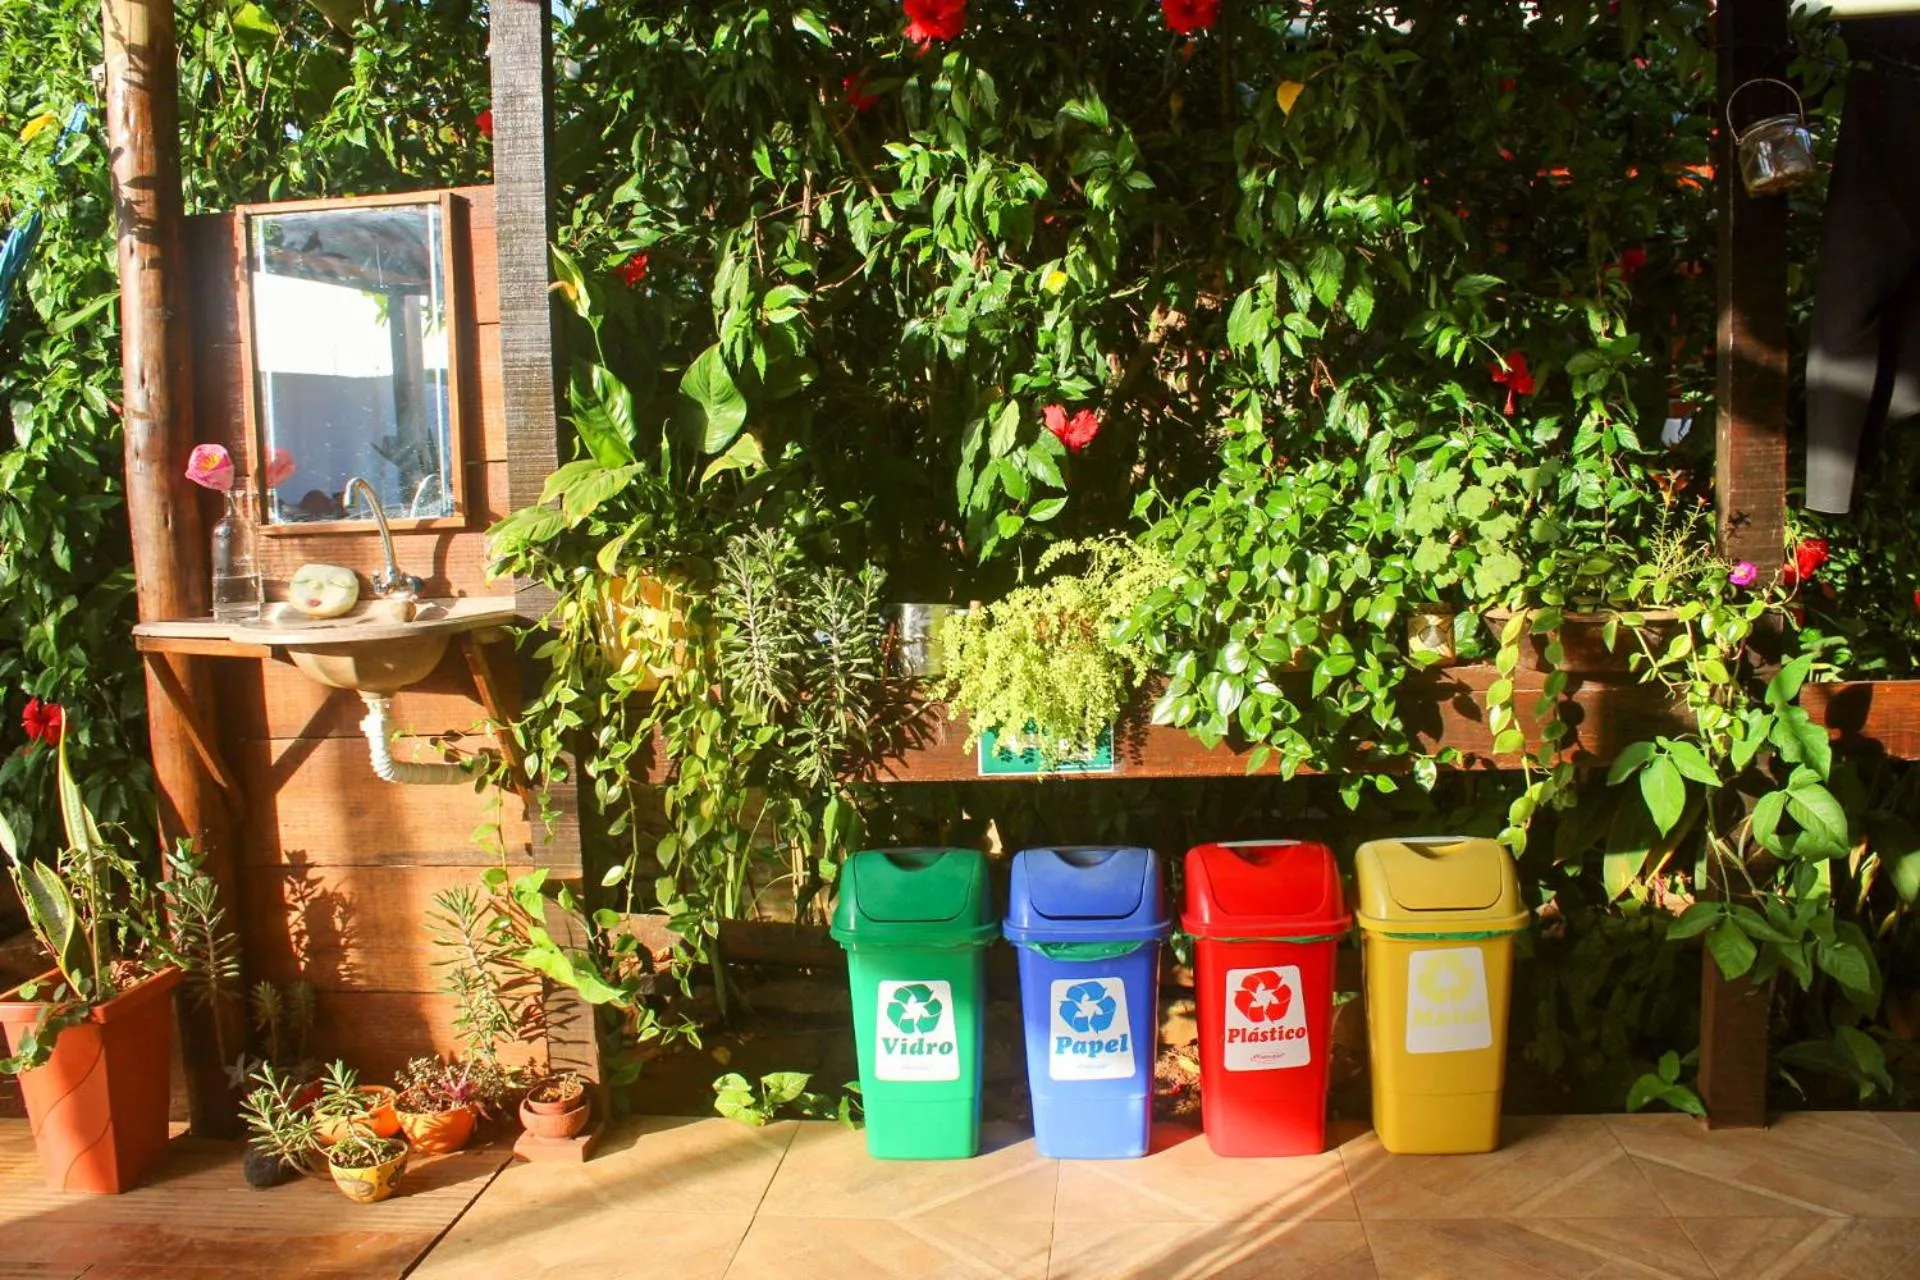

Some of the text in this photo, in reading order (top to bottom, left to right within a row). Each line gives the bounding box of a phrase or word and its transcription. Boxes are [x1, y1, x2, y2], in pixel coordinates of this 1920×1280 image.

[1227, 1025, 1306, 1043] Plástico
[882, 1037, 953, 1055] Vidro
[1056, 1034, 1128, 1057] Papel
